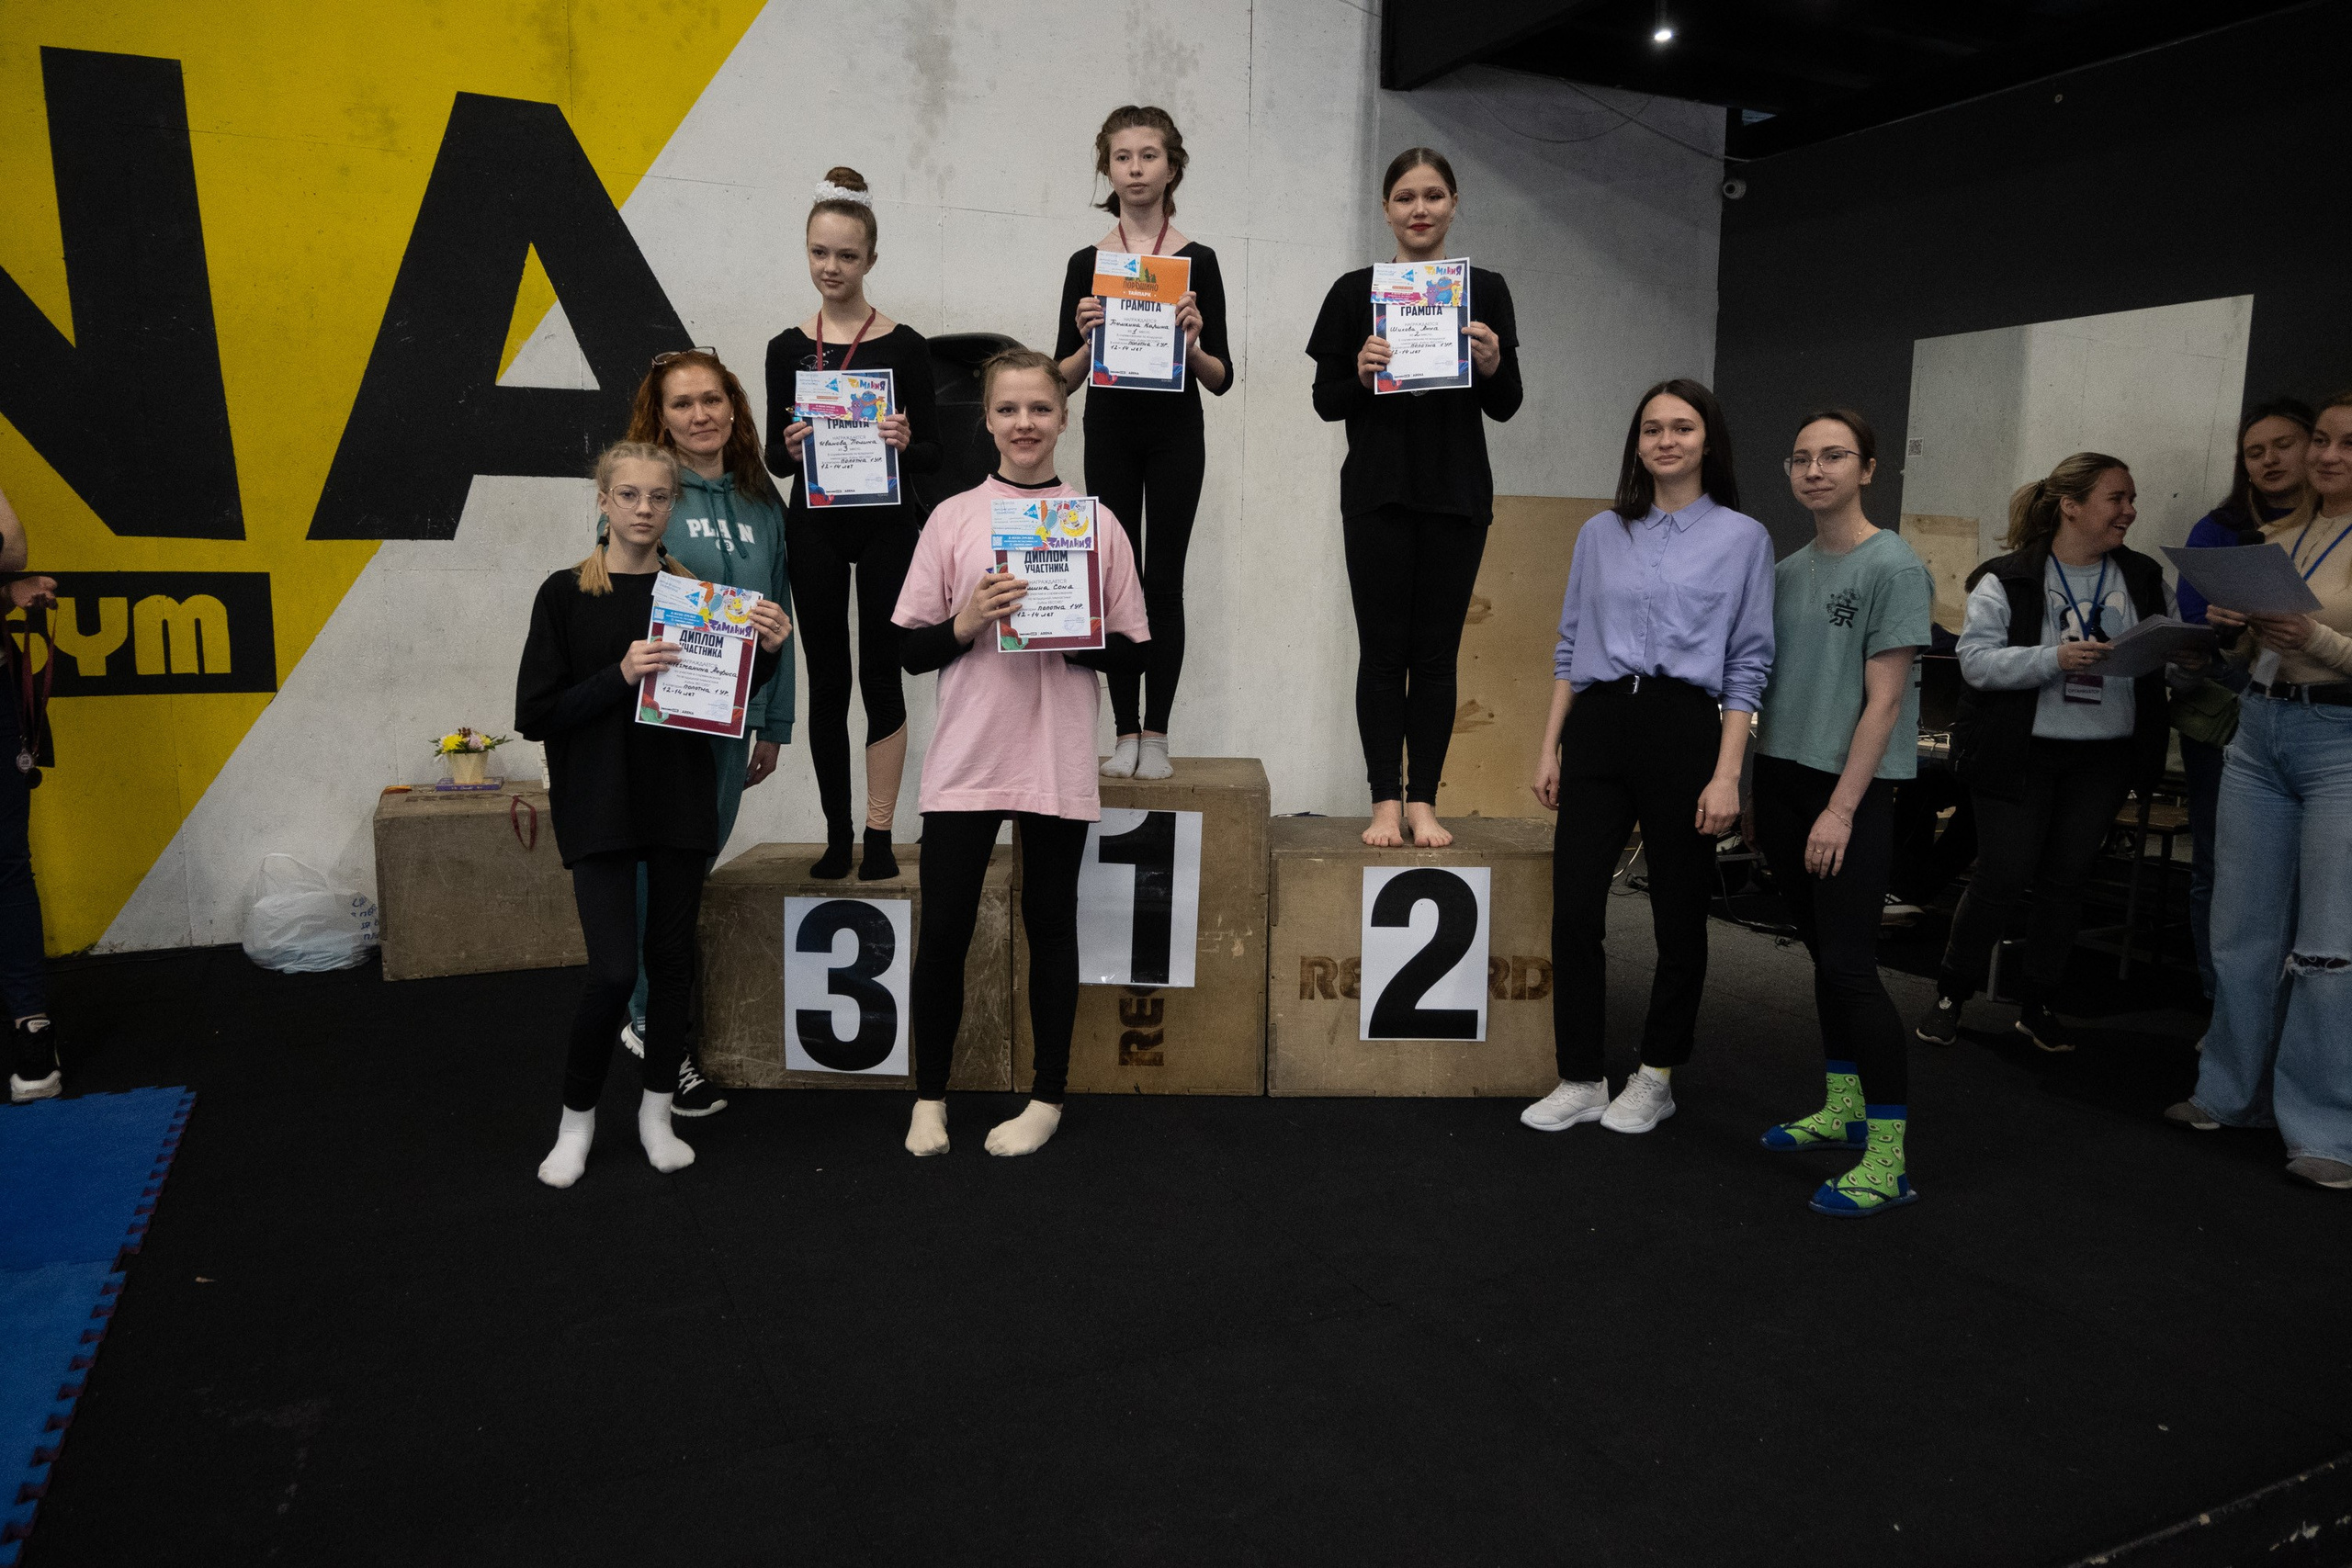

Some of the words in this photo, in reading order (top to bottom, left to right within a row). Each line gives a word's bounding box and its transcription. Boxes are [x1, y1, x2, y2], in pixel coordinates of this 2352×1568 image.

[1123, 281, 1159, 292] ПОРОШИНО
[1120, 299, 1162, 312] ГРАМОТА
[1400, 305, 1442, 317] ГРАМОТА
[1024, 550, 1069, 564] ДИПЛОМ
[1024, 563, 1069, 574] УЧАСТНИКА
[679, 629, 724, 649] ДИПЛОМ
[1098, 811, 1177, 985] 1
[1368, 868, 1478, 1039] 2
[796, 899, 898, 1071] 3
